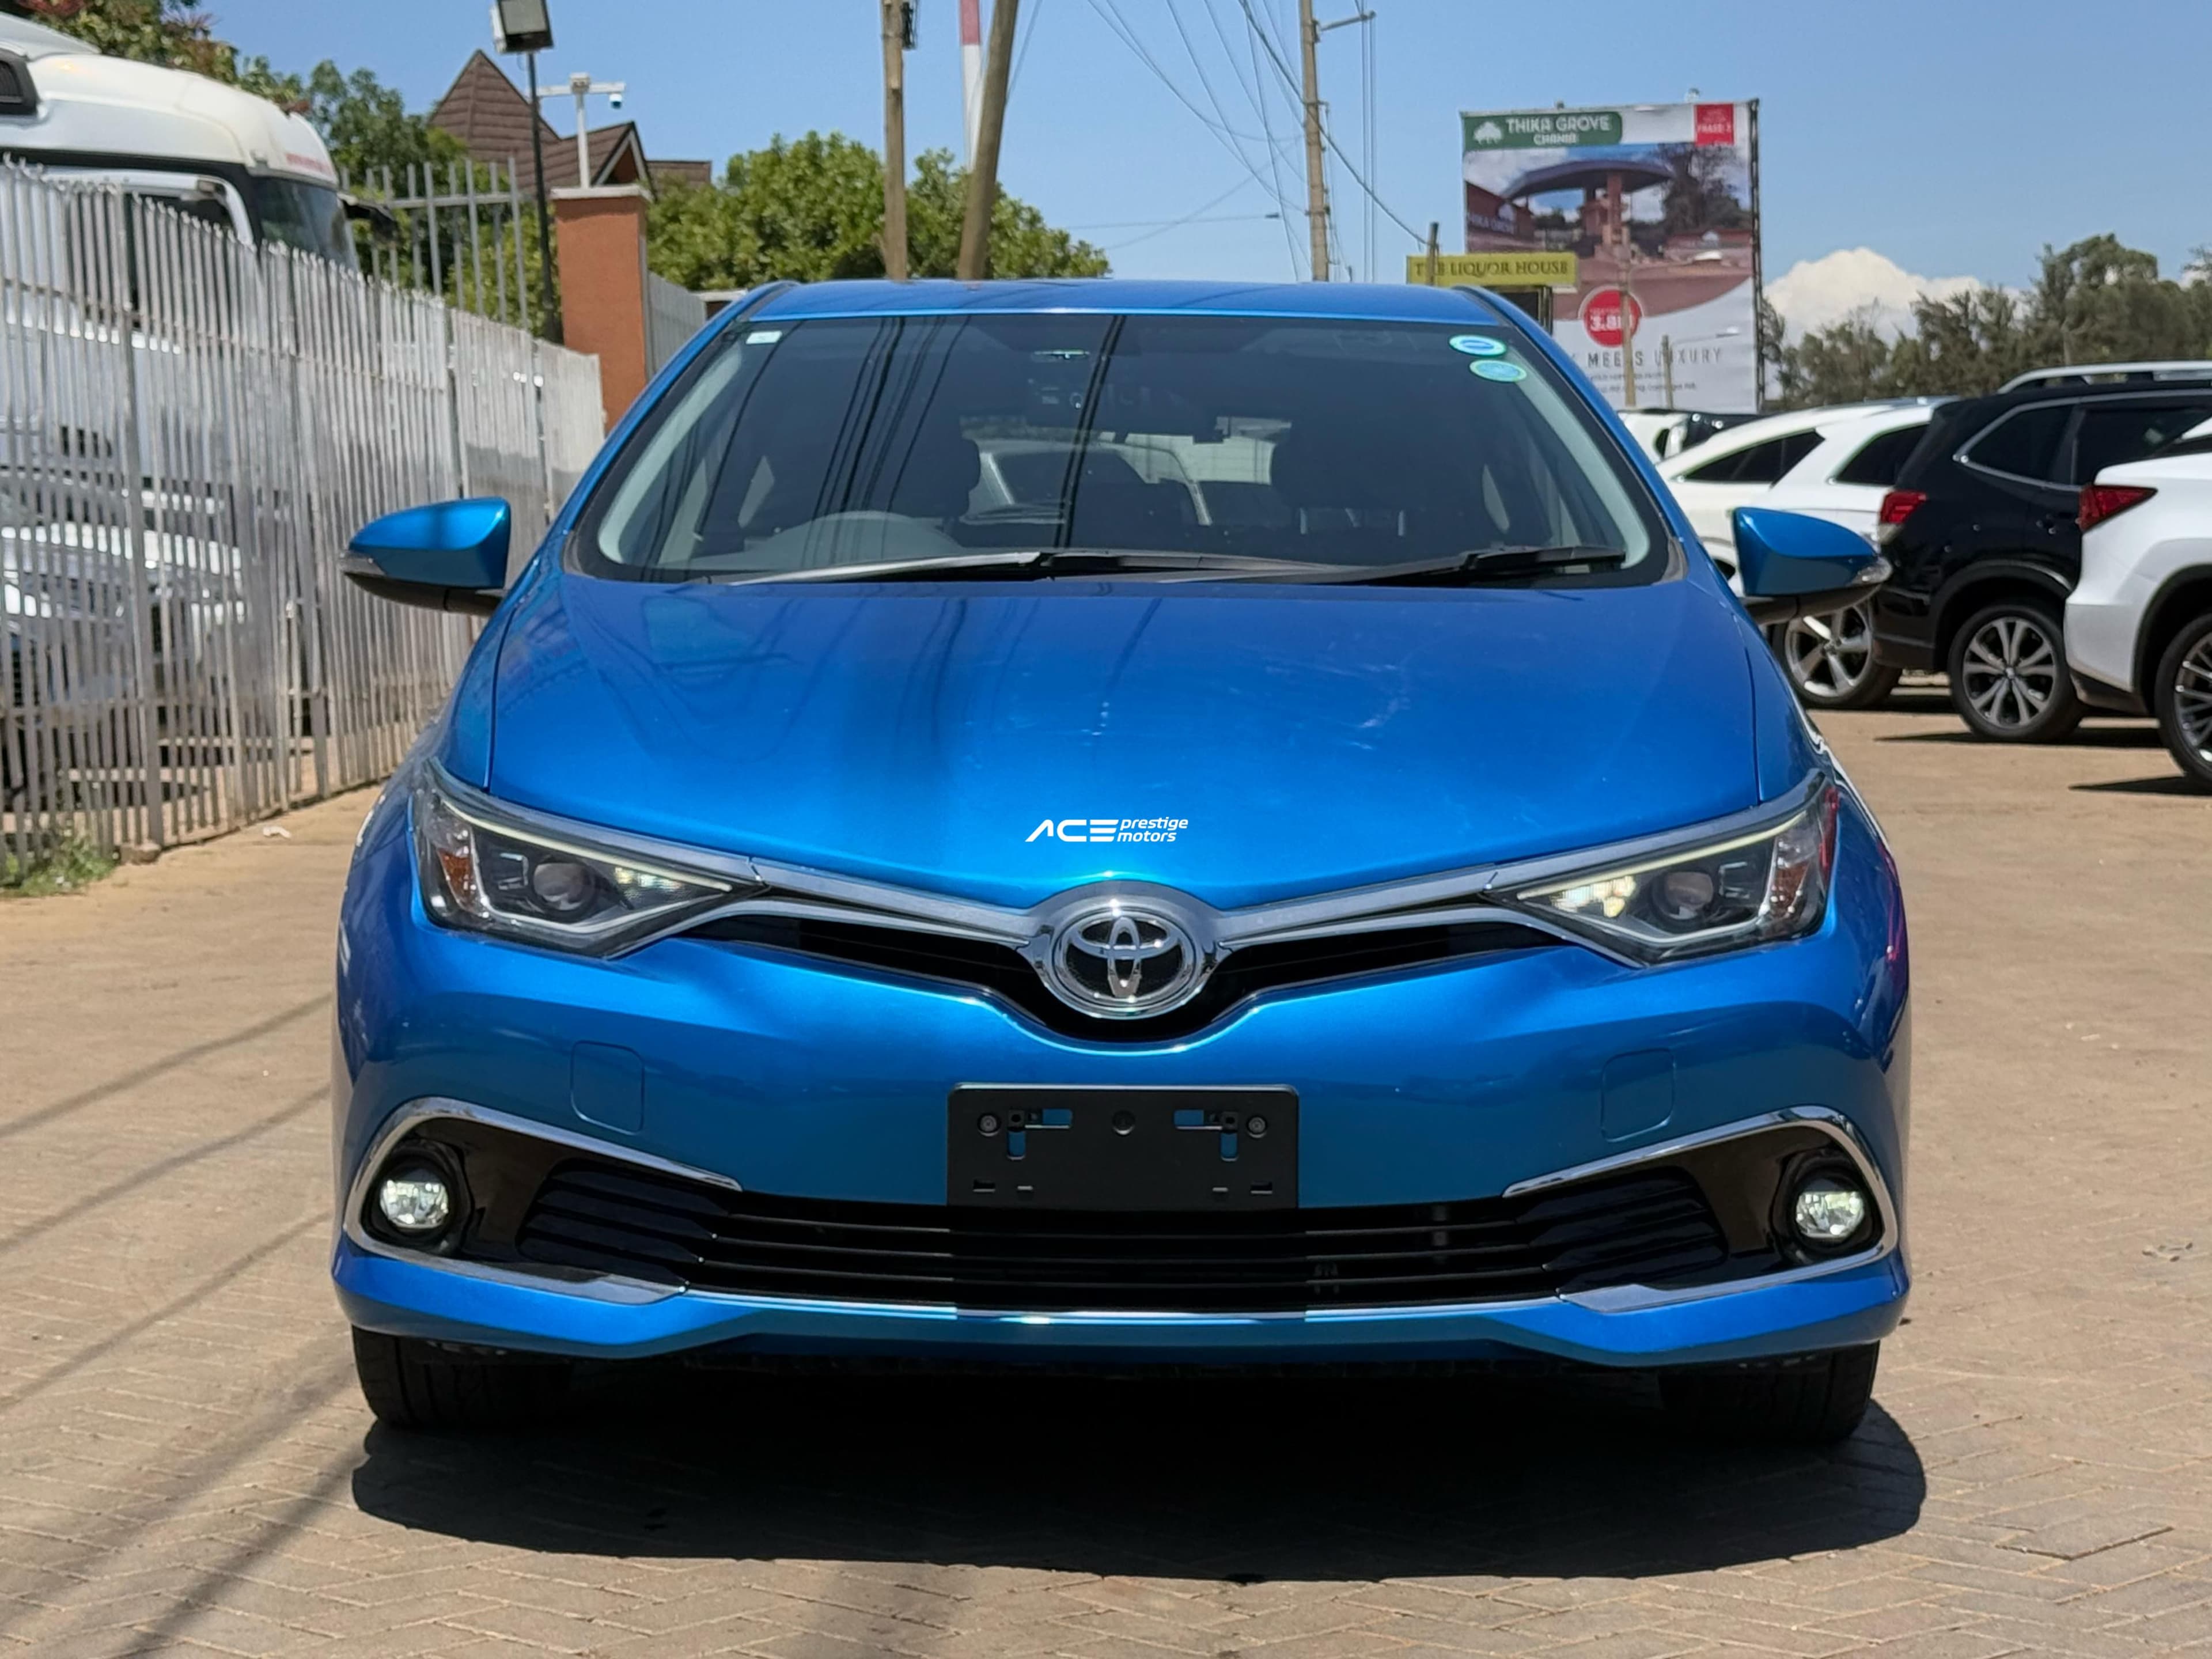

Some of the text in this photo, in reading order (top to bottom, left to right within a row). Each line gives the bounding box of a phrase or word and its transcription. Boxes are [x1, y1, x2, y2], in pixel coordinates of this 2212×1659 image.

[1506, 115, 1610, 134] THIKA GROVE
[1416, 260, 1568, 278] TE LIQUOR HOUSE
[1588, 349, 1644, 369] MEES
